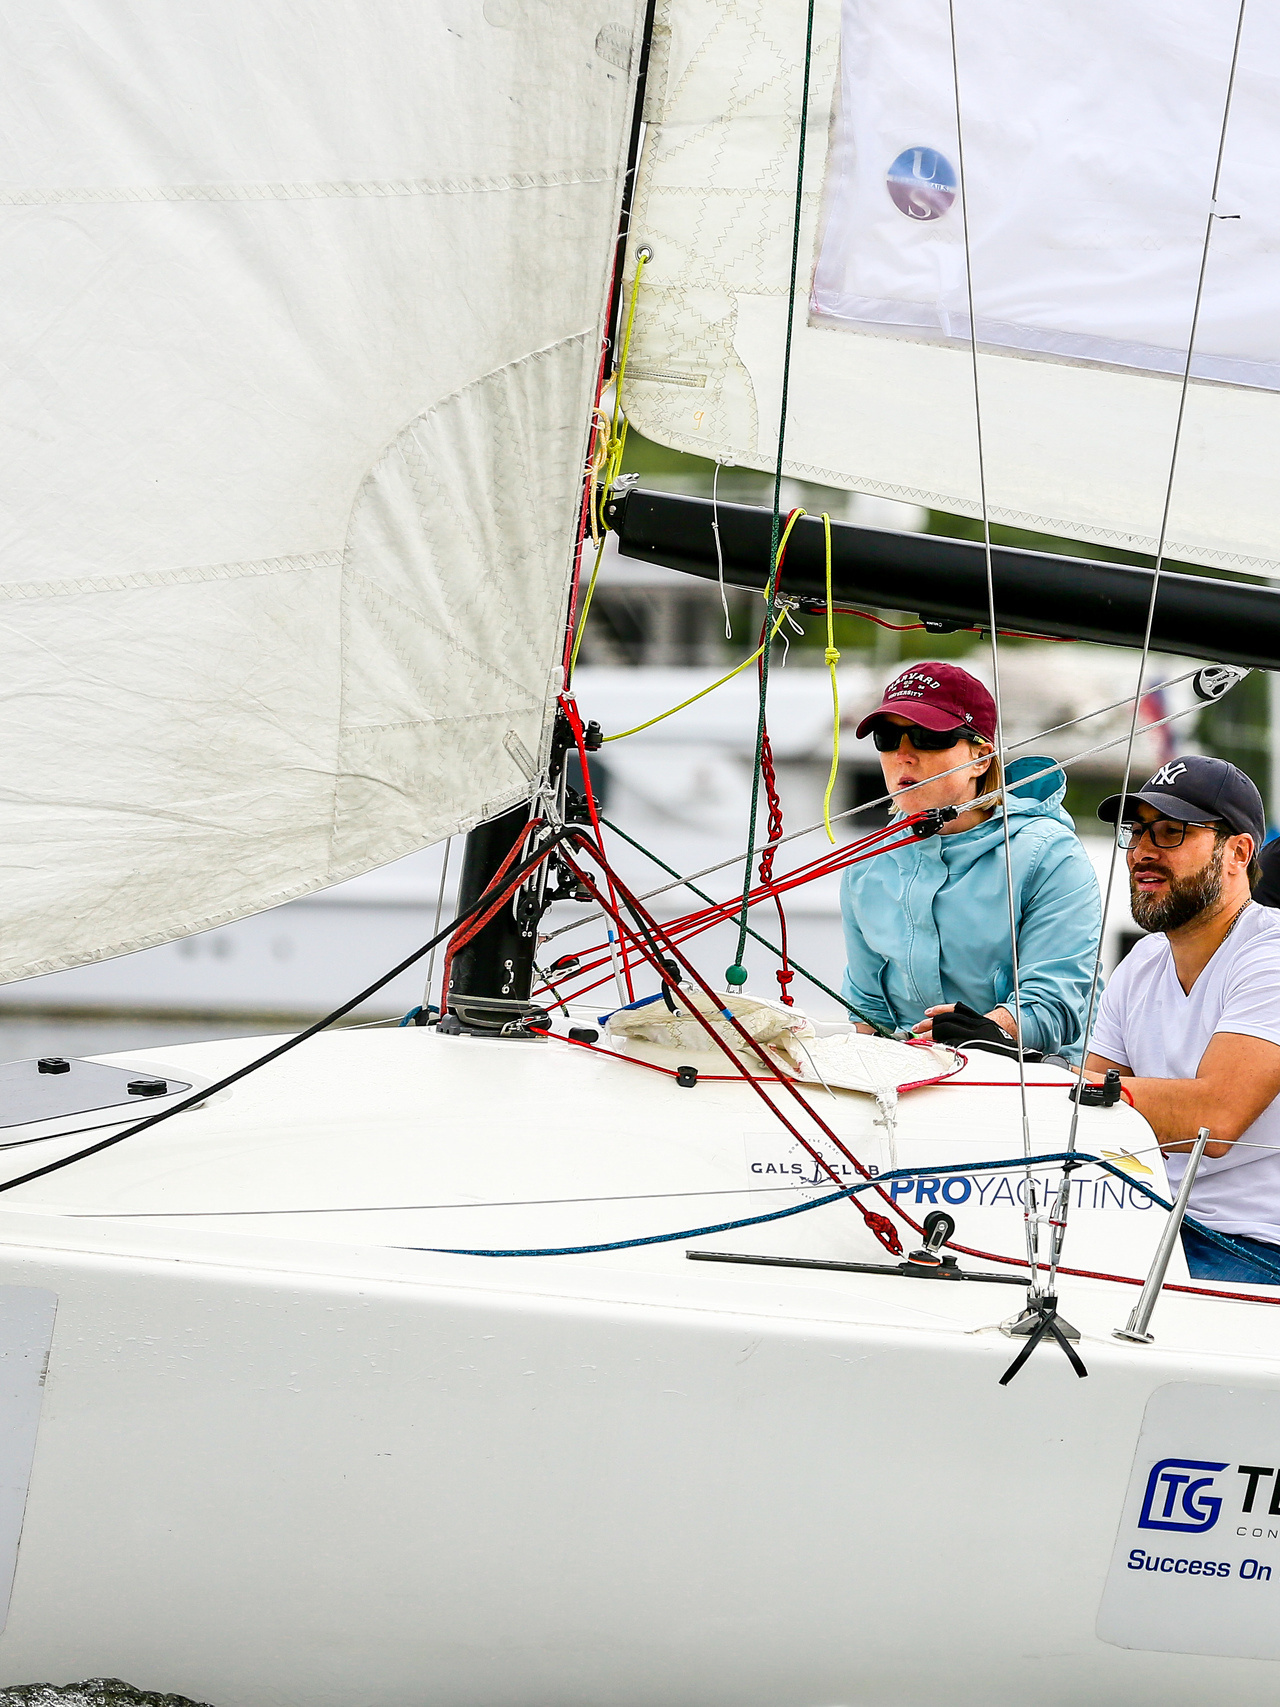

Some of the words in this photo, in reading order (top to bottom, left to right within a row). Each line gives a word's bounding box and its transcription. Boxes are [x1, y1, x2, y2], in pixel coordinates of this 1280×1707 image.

[887, 672, 941, 692] HARVARD
[1150, 762, 1188, 786] NY
[751, 1163, 803, 1174] GALS
[1127, 1549, 1231, 1578] Success
[1239, 1559, 1271, 1581] On
